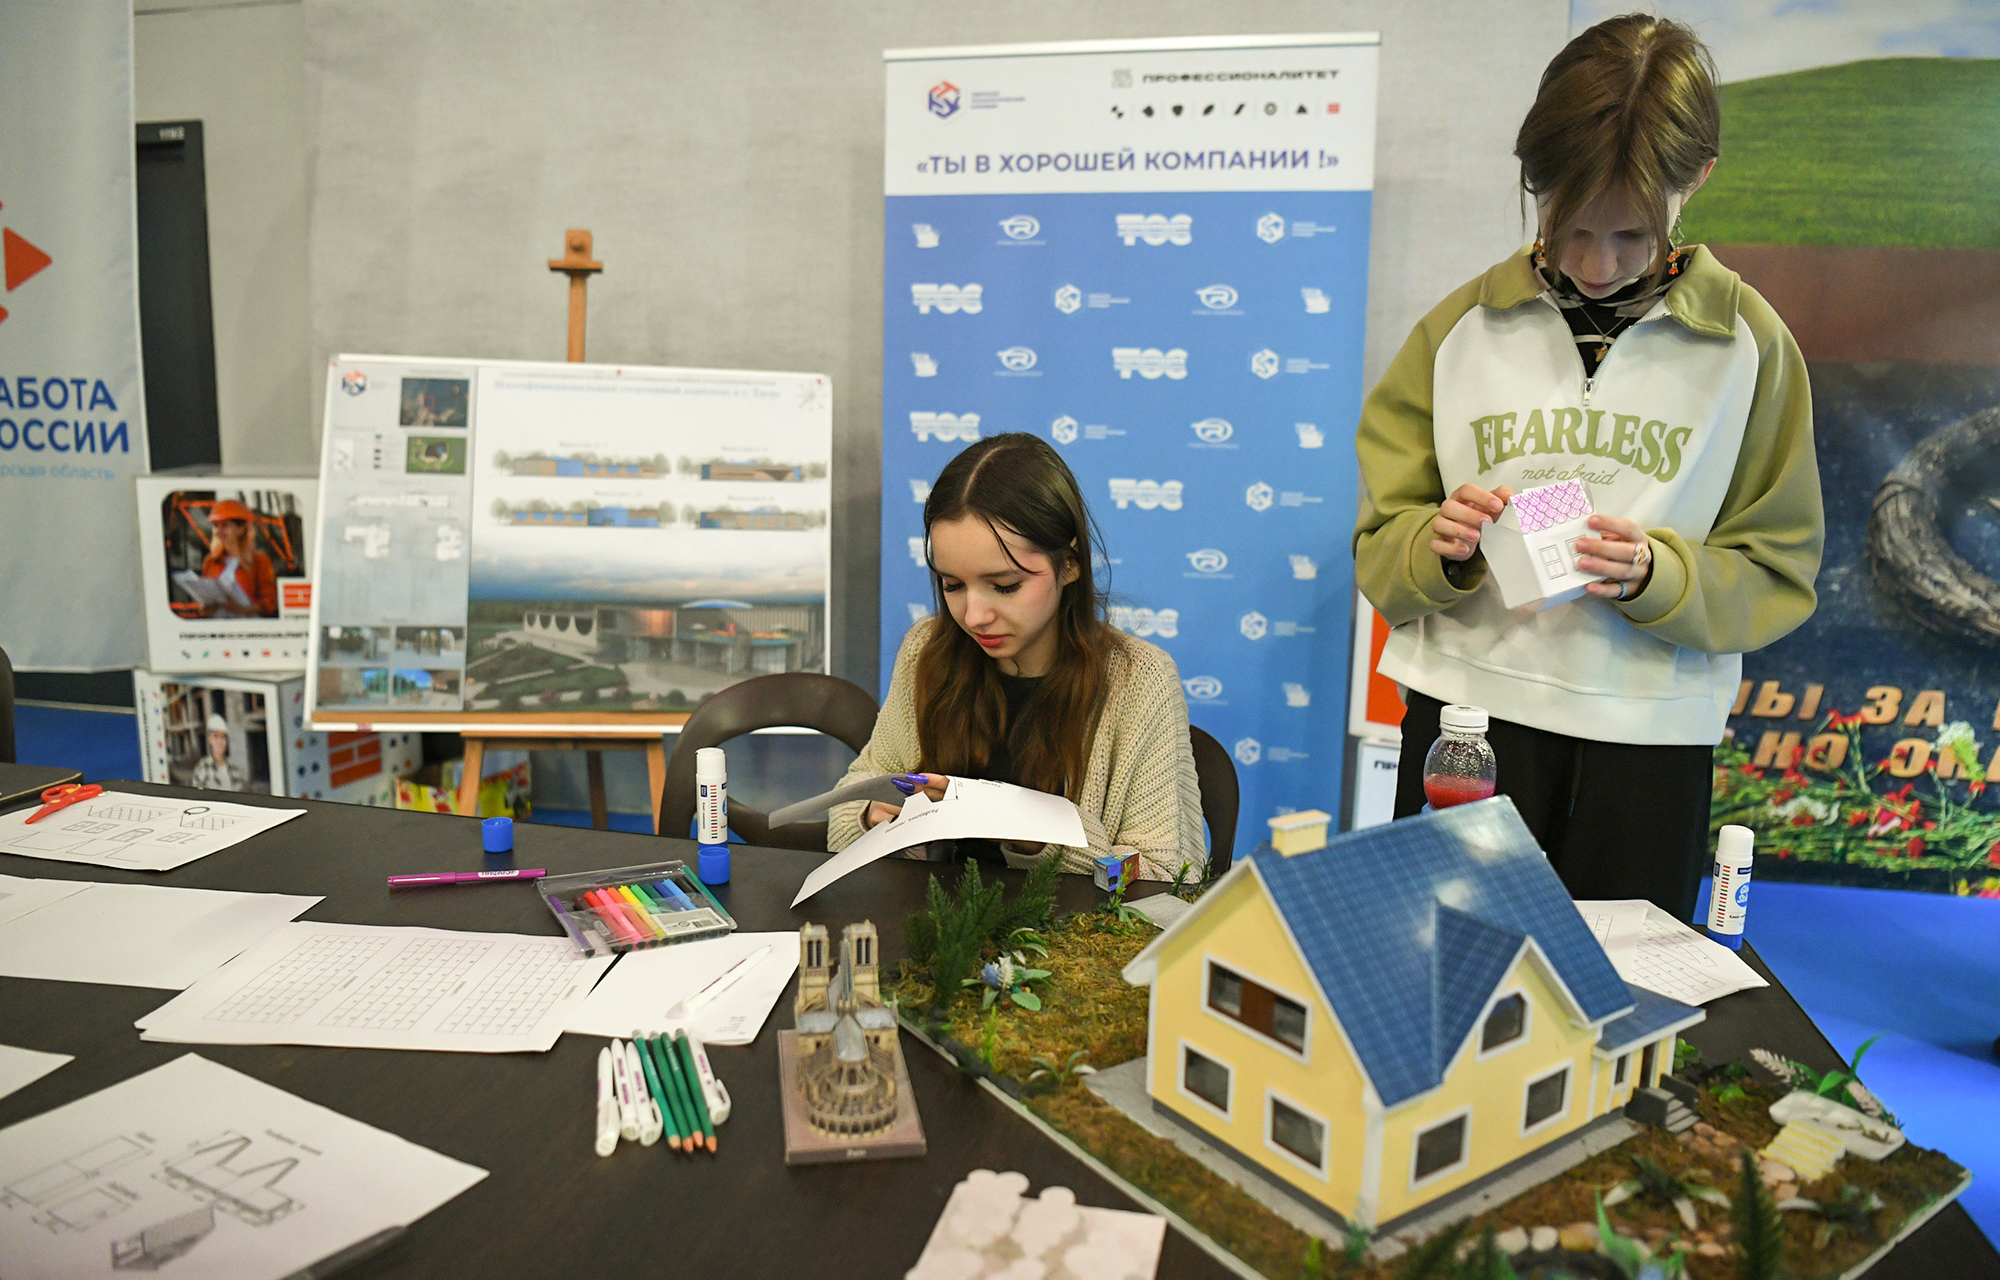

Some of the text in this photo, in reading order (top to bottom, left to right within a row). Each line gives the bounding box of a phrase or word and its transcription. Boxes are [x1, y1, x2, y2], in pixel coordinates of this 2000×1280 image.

[1143, 69, 1340, 83] ПРОФЕССИОНАЛИТЕТ
[916, 156, 966, 174] «ТЫ
[975, 157, 990, 173] В
[1000, 147, 1135, 173] ХОРОШЕЙ
[1145, 150, 1310, 171] КОМПАНИИ
[1469, 406, 1694, 484] FEARLESS
[1522, 463, 1621, 486] not afraid
[1860, 684, 1946, 727] ЗА
[1752, 731, 1851, 771] НО
